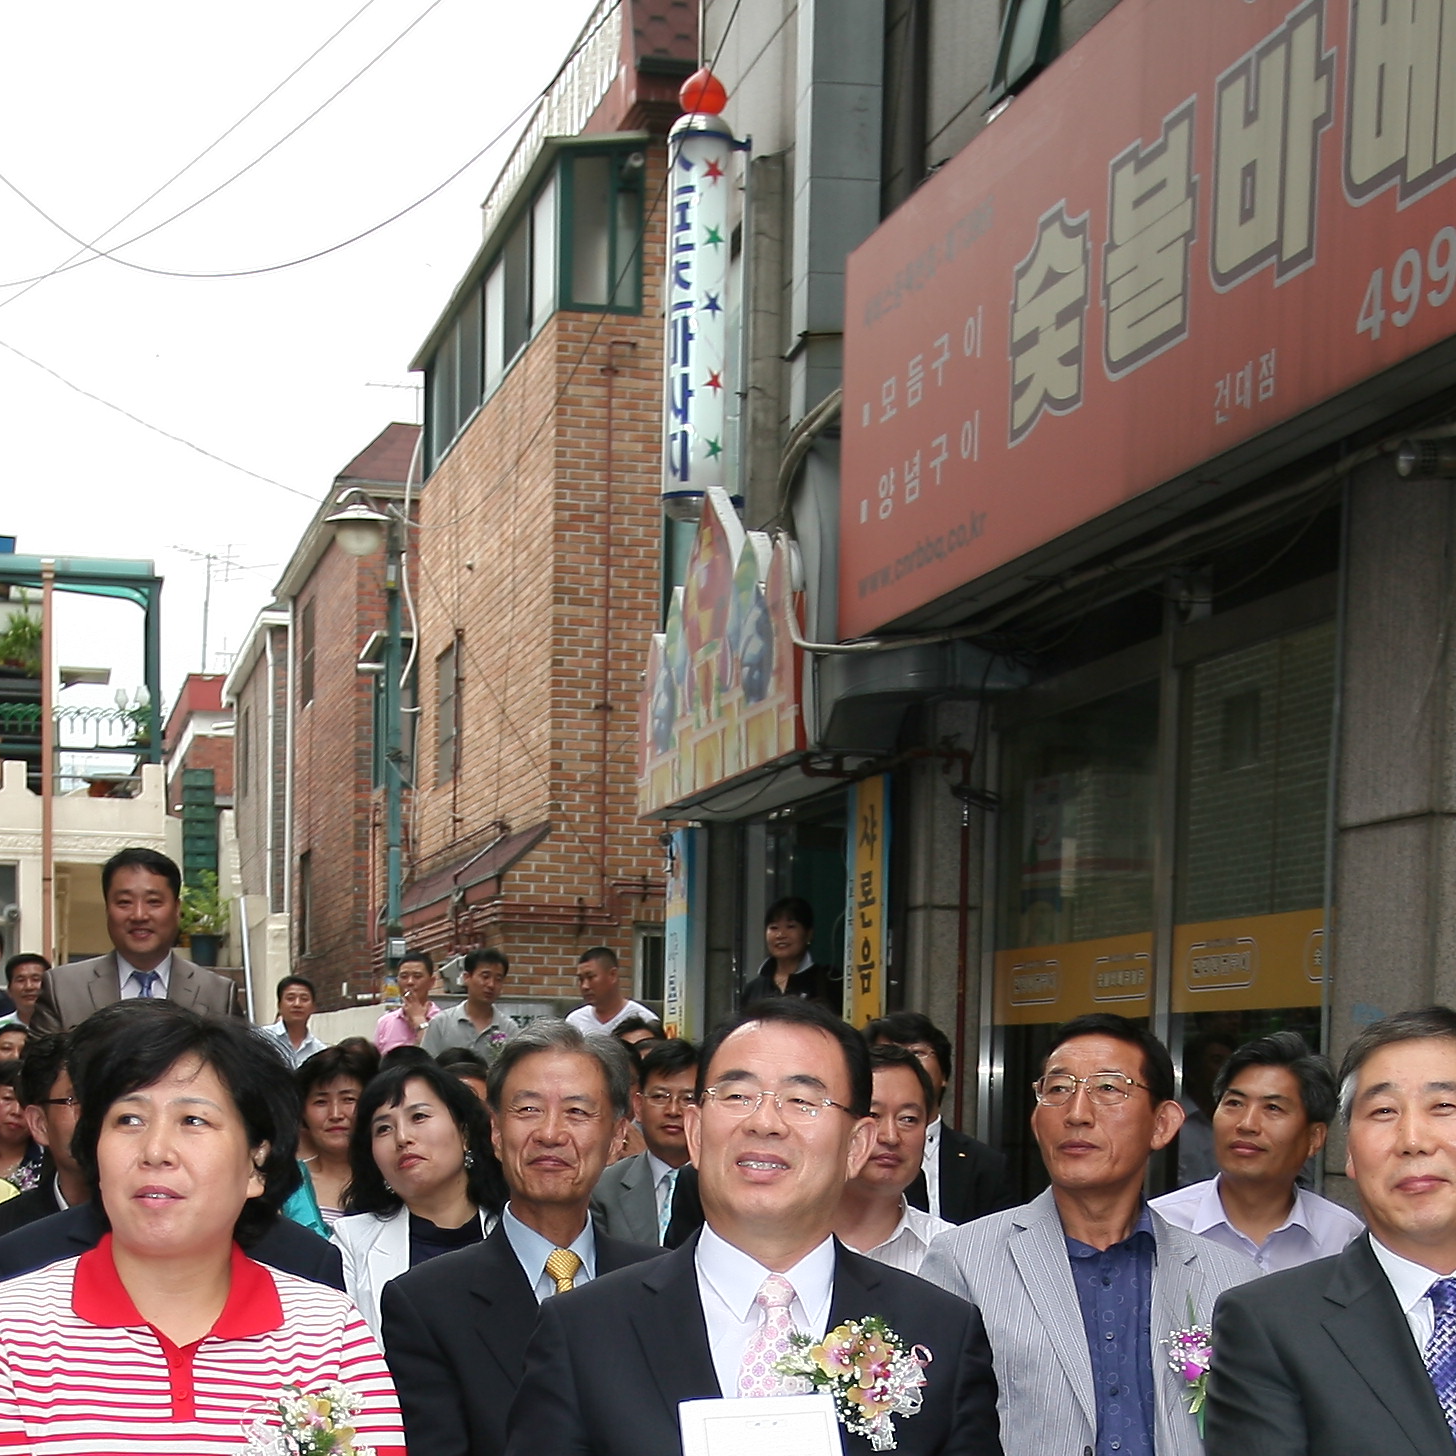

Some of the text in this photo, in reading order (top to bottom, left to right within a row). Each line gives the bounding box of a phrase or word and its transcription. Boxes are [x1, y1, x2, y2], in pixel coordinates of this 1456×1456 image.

[879, 304, 982, 424] 모듬구이
[1214, 347, 1277, 426] 건대점
[877, 409, 981, 521] 양념구이
[857, 803, 881, 1021] 샤론음
